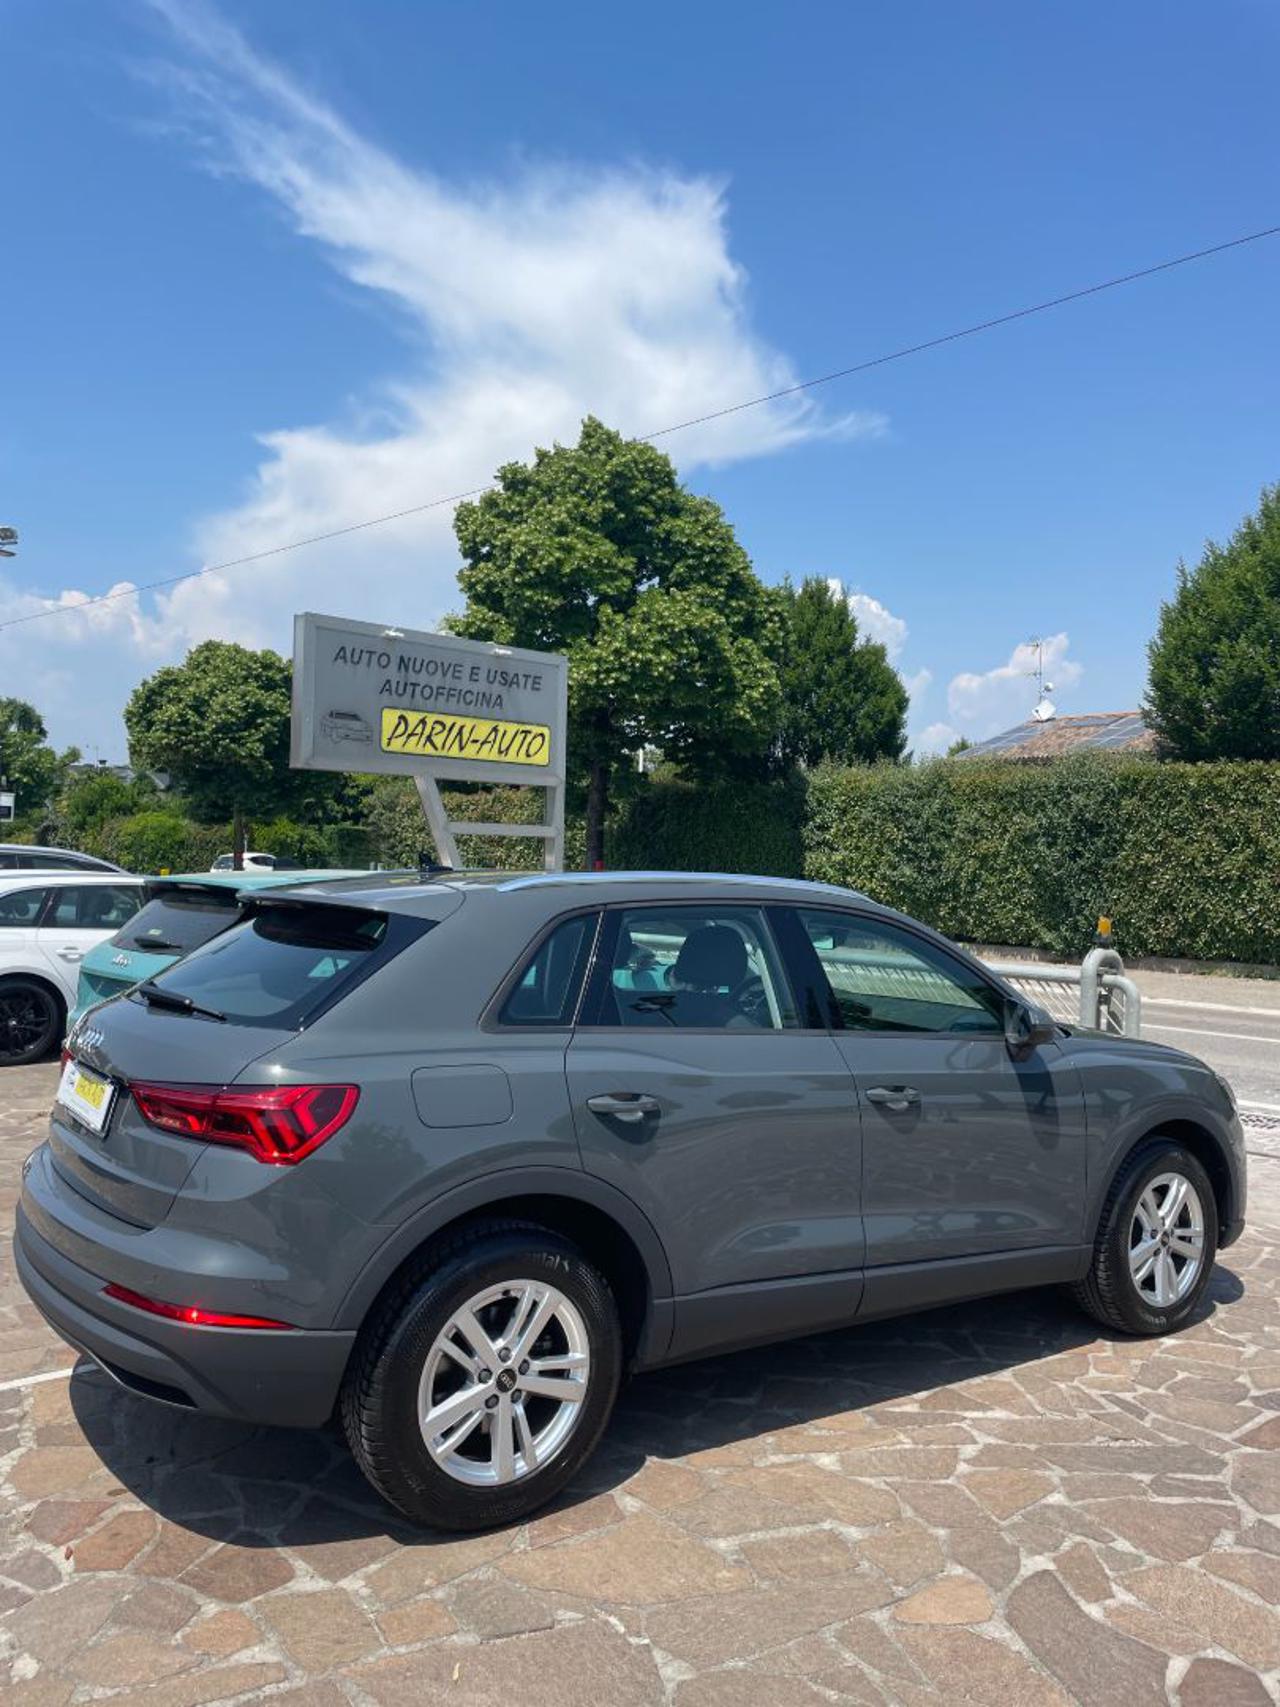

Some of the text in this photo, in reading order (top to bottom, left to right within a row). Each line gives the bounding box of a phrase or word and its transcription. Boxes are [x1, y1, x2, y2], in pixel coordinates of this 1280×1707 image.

[334, 646, 542, 691] AUTO NUOVE E USATE
[380, 679, 503, 709] AUTOFFICINA
[386, 714, 546, 758] PARIN-AUTO
